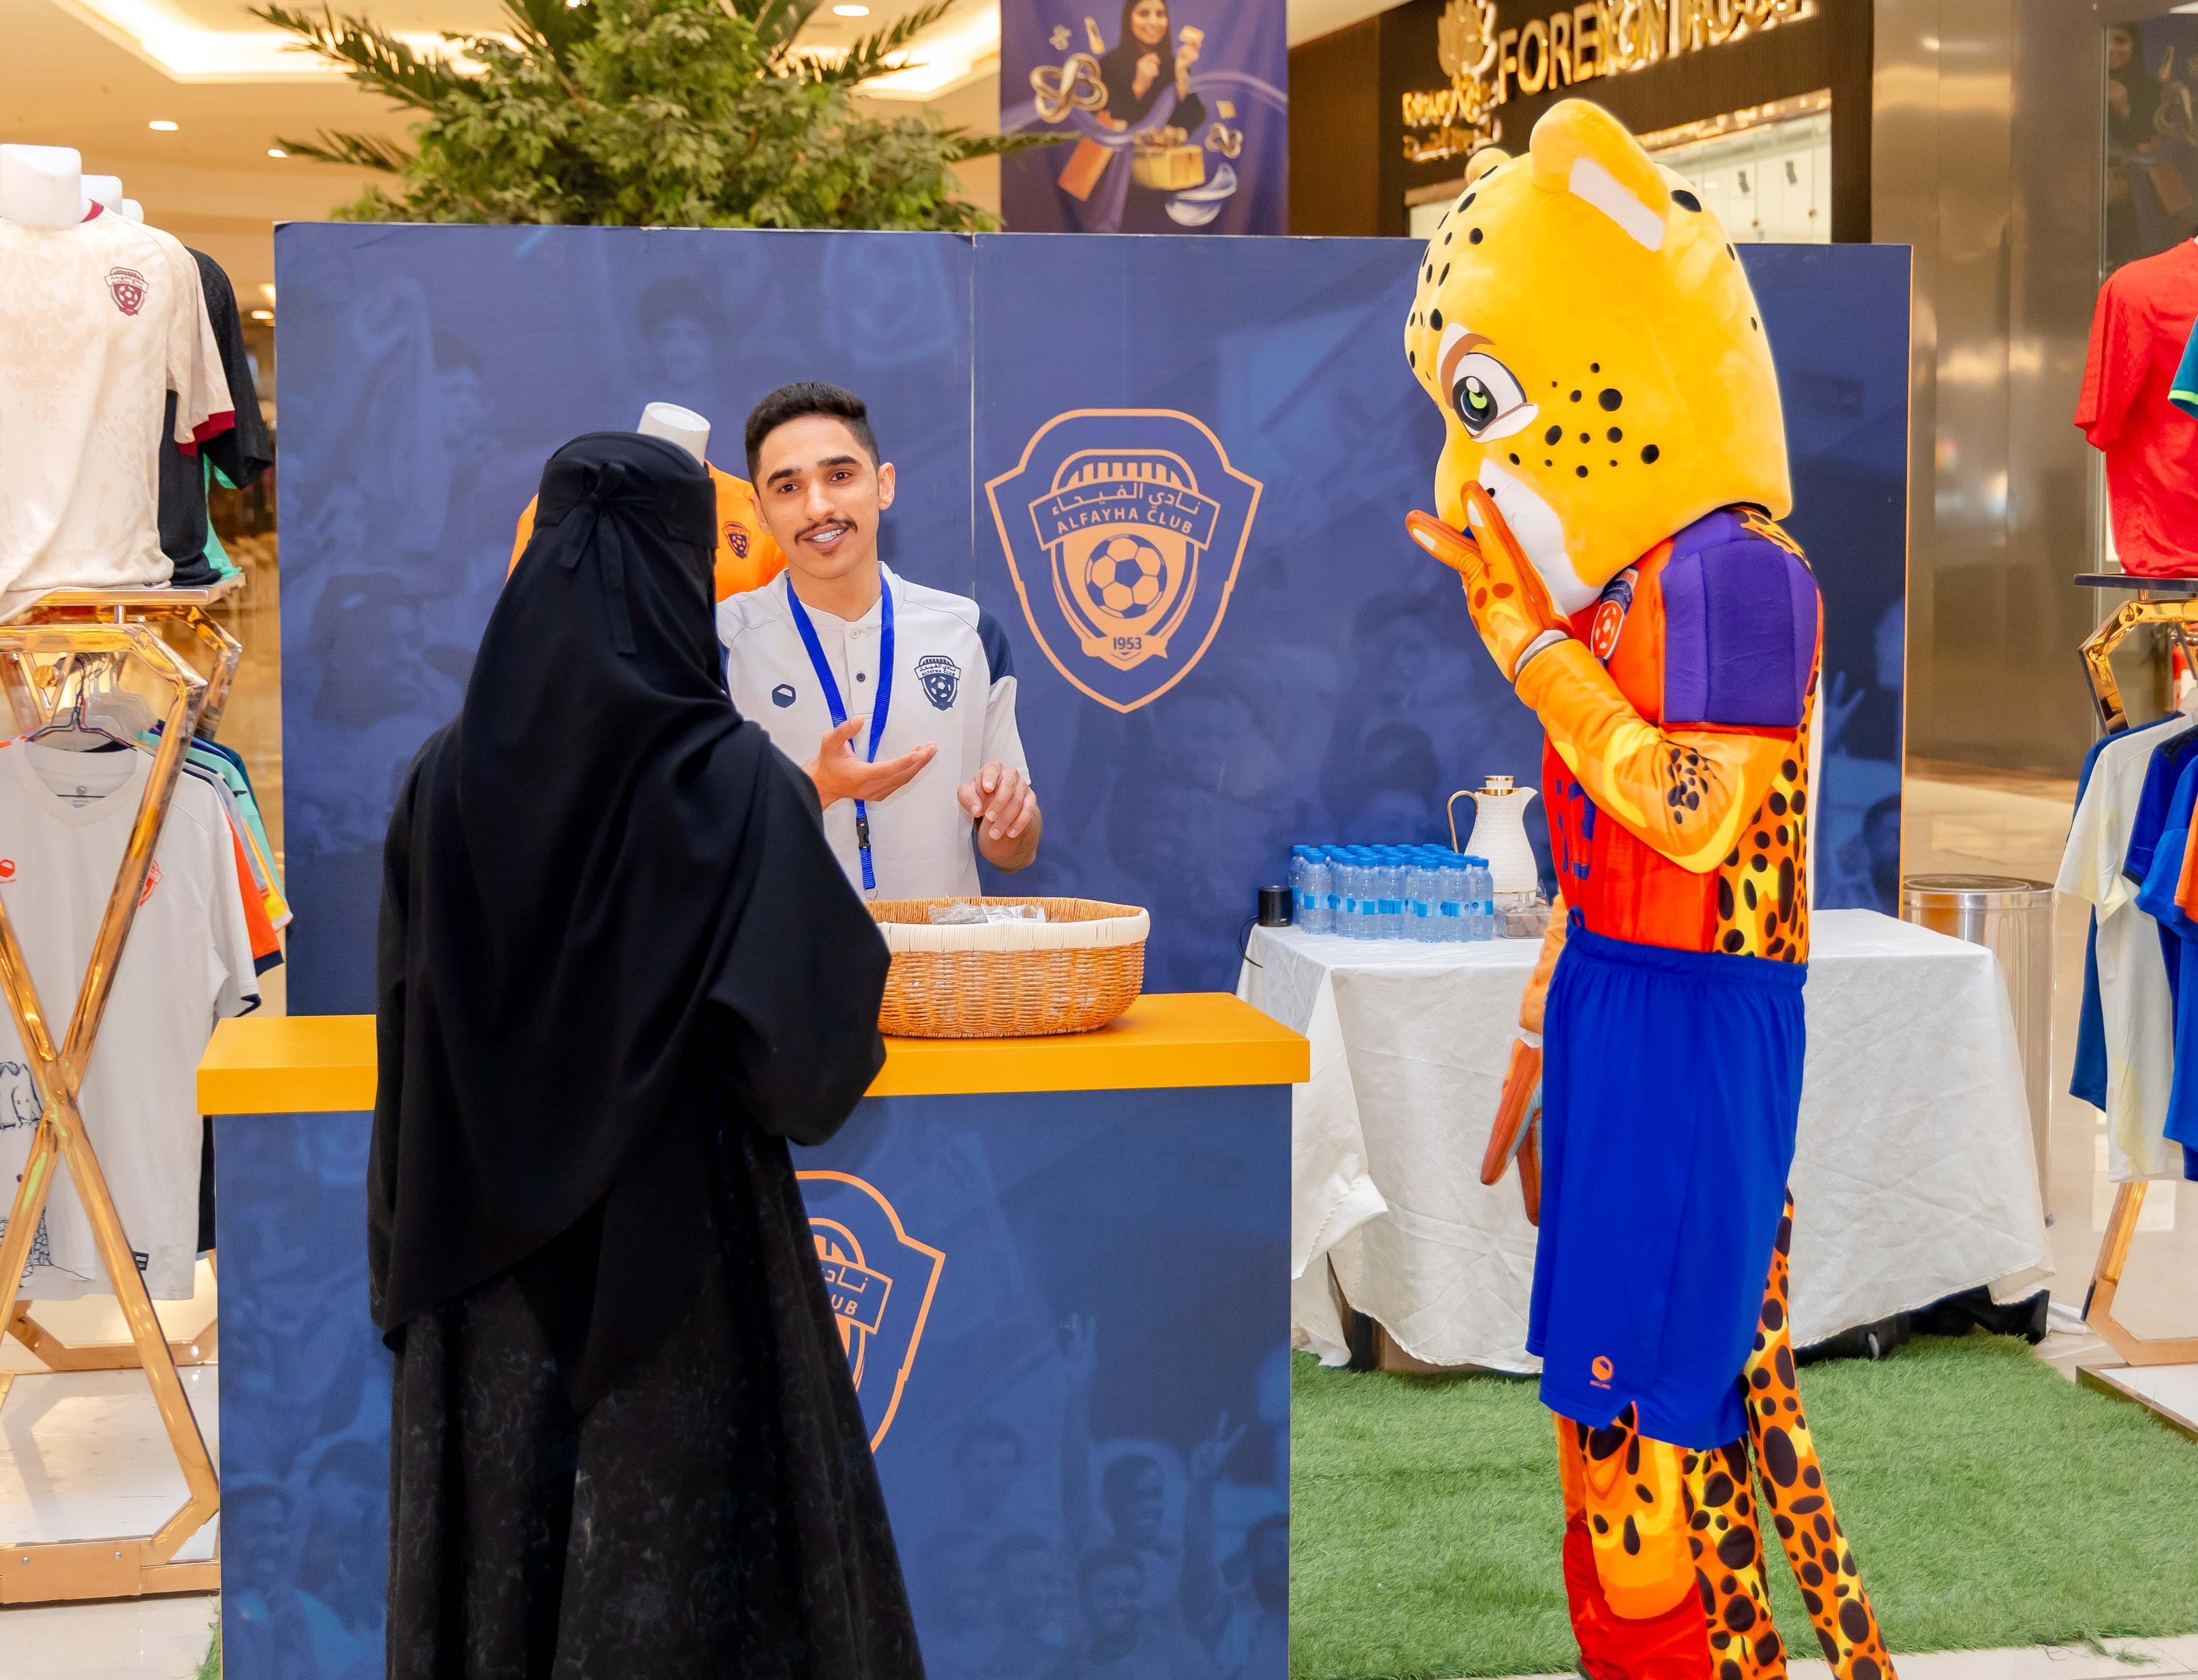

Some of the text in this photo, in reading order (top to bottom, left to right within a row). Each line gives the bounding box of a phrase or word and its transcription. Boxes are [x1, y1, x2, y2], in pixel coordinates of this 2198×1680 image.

[1051, 482, 1201, 516] نادي الفيحاء
[1056, 507, 1193, 535] ALFAYHA CLUB
[1113, 637, 1142, 649] 1953
[822, 1266, 868, 1293] ناد
[831, 1294, 858, 1315] UB
